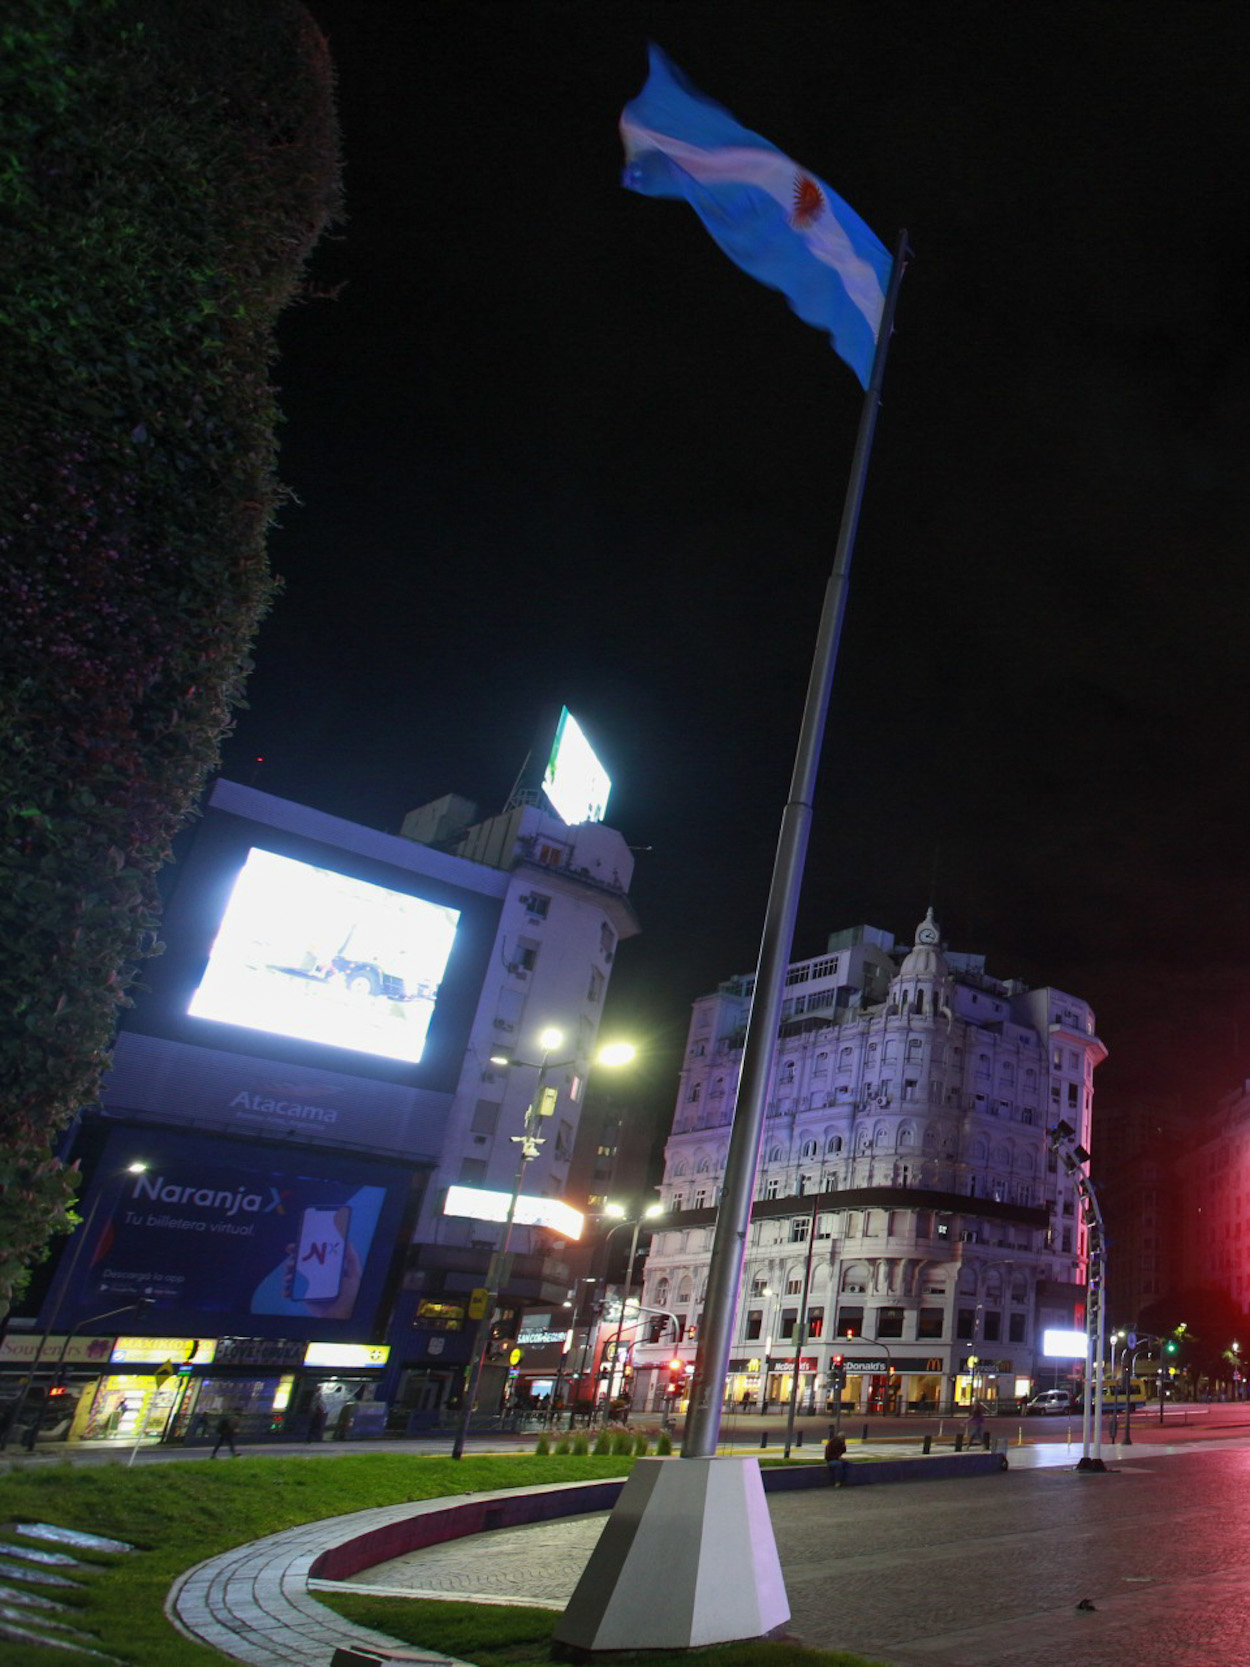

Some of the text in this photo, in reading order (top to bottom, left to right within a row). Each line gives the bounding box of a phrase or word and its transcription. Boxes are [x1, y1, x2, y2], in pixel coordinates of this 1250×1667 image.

[229, 1091, 338, 1122] Atacama
[132, 1174, 262, 1216] Naranja
[125, 1212, 143, 1225] Tu
[146, 1213, 206, 1232] billetera
[2, 1341, 82, 1356] Souenrs
[774, 1362, 810, 1371] McDonld's
